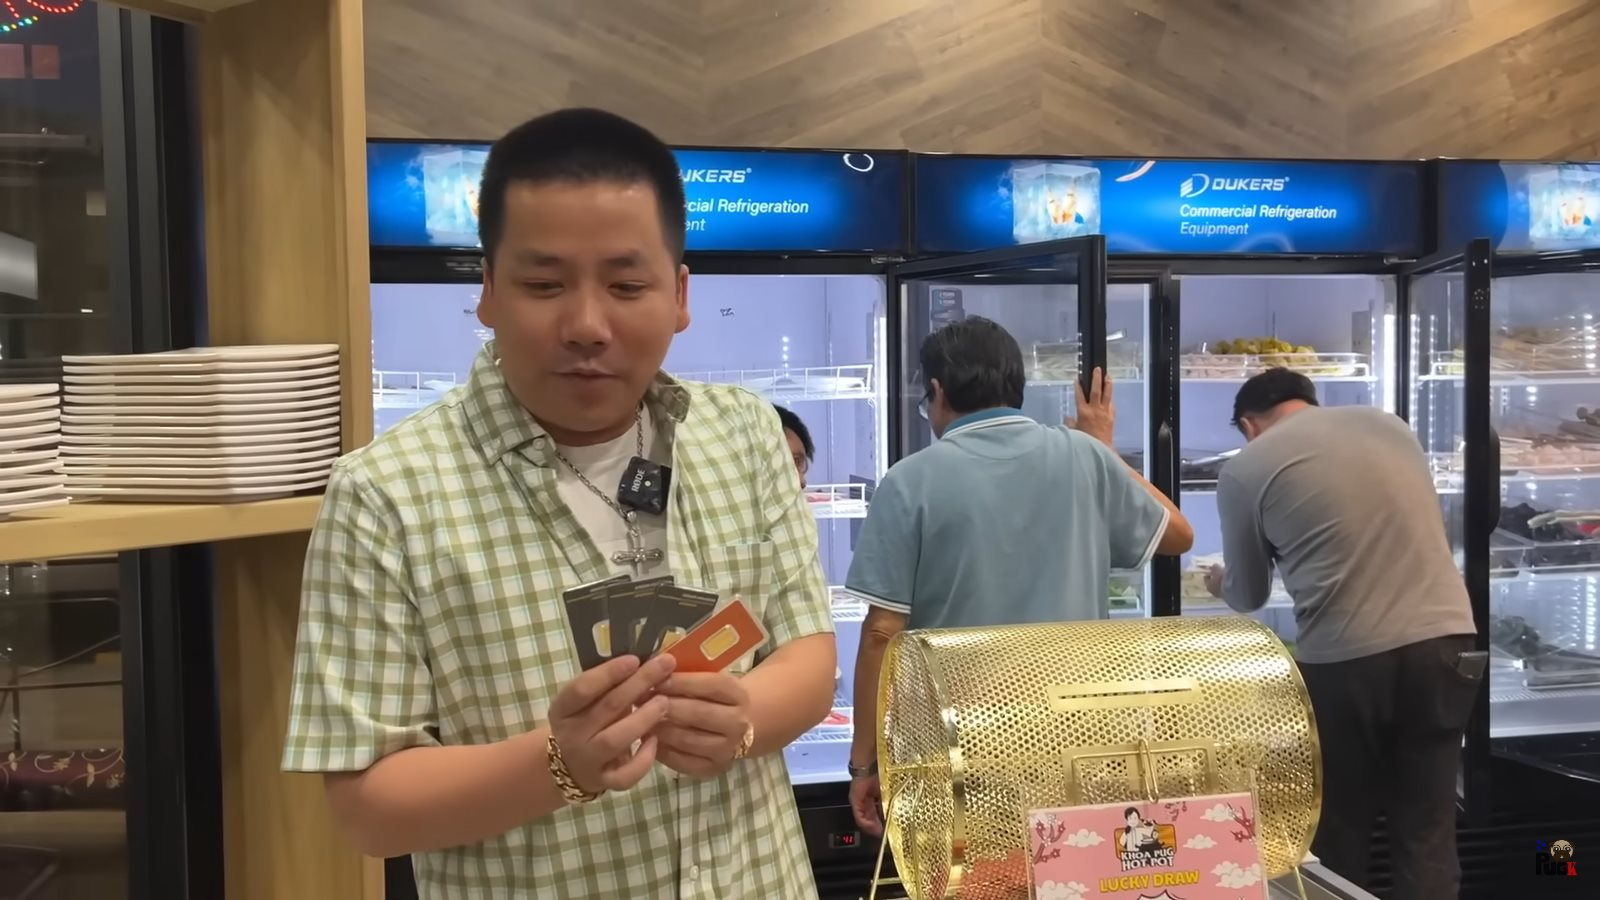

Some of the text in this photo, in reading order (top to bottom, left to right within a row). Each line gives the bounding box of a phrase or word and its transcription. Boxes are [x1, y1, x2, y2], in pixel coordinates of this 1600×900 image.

[679, 169, 746, 183] UKERS
[1212, 178, 1285, 191] DUKERS
[718, 198, 809, 216] Refrigeration
[1180, 204, 1337, 221] Commercial Refrigeration
[1180, 222, 1249, 237] Equipment
[1121, 847, 1174, 861] KHOA PUG
[1122, 856, 1174, 872] HOT POT
[1100, 871, 1199, 893] LUCKY DRAW
